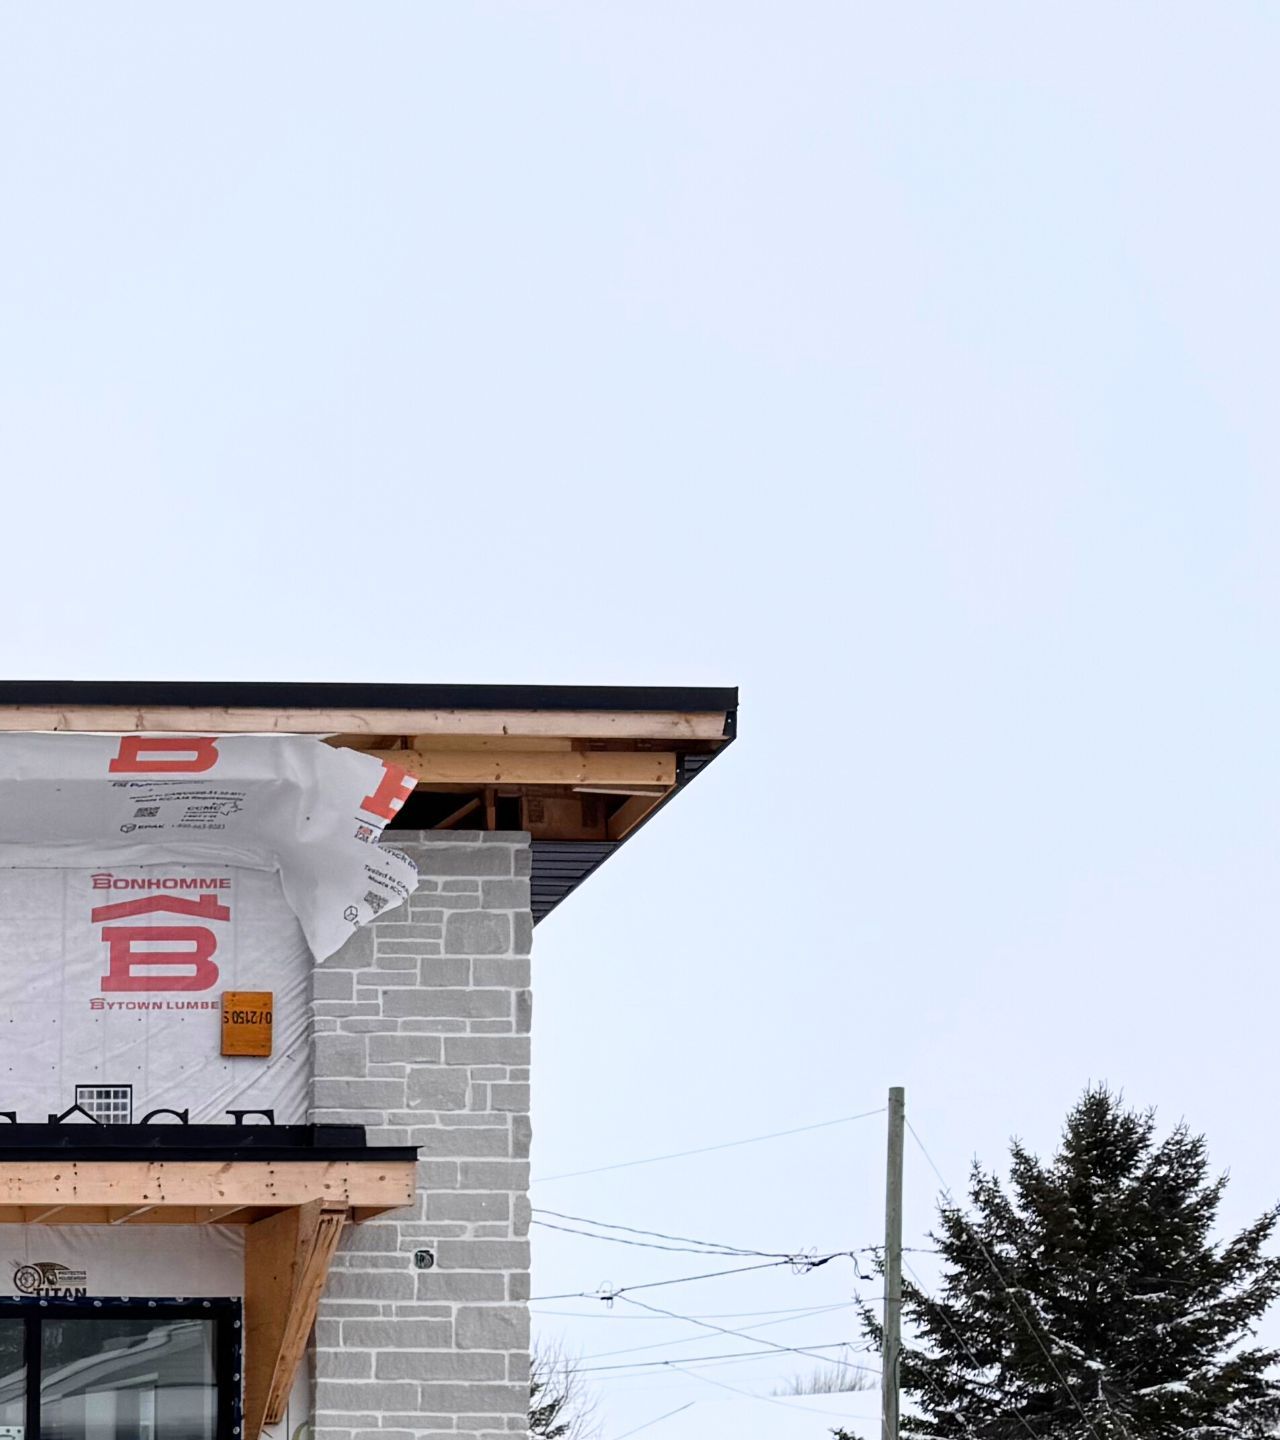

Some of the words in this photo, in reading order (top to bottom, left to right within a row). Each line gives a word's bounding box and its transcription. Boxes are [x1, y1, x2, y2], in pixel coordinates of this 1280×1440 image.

[90, 872, 232, 890] BONHOMME
[100, 925, 219, 992] B
[90, 998, 163, 1010] BYTOWN
[166, 1001, 219, 1010] LUMBE
[33, 1287, 87, 1297] TITAN
